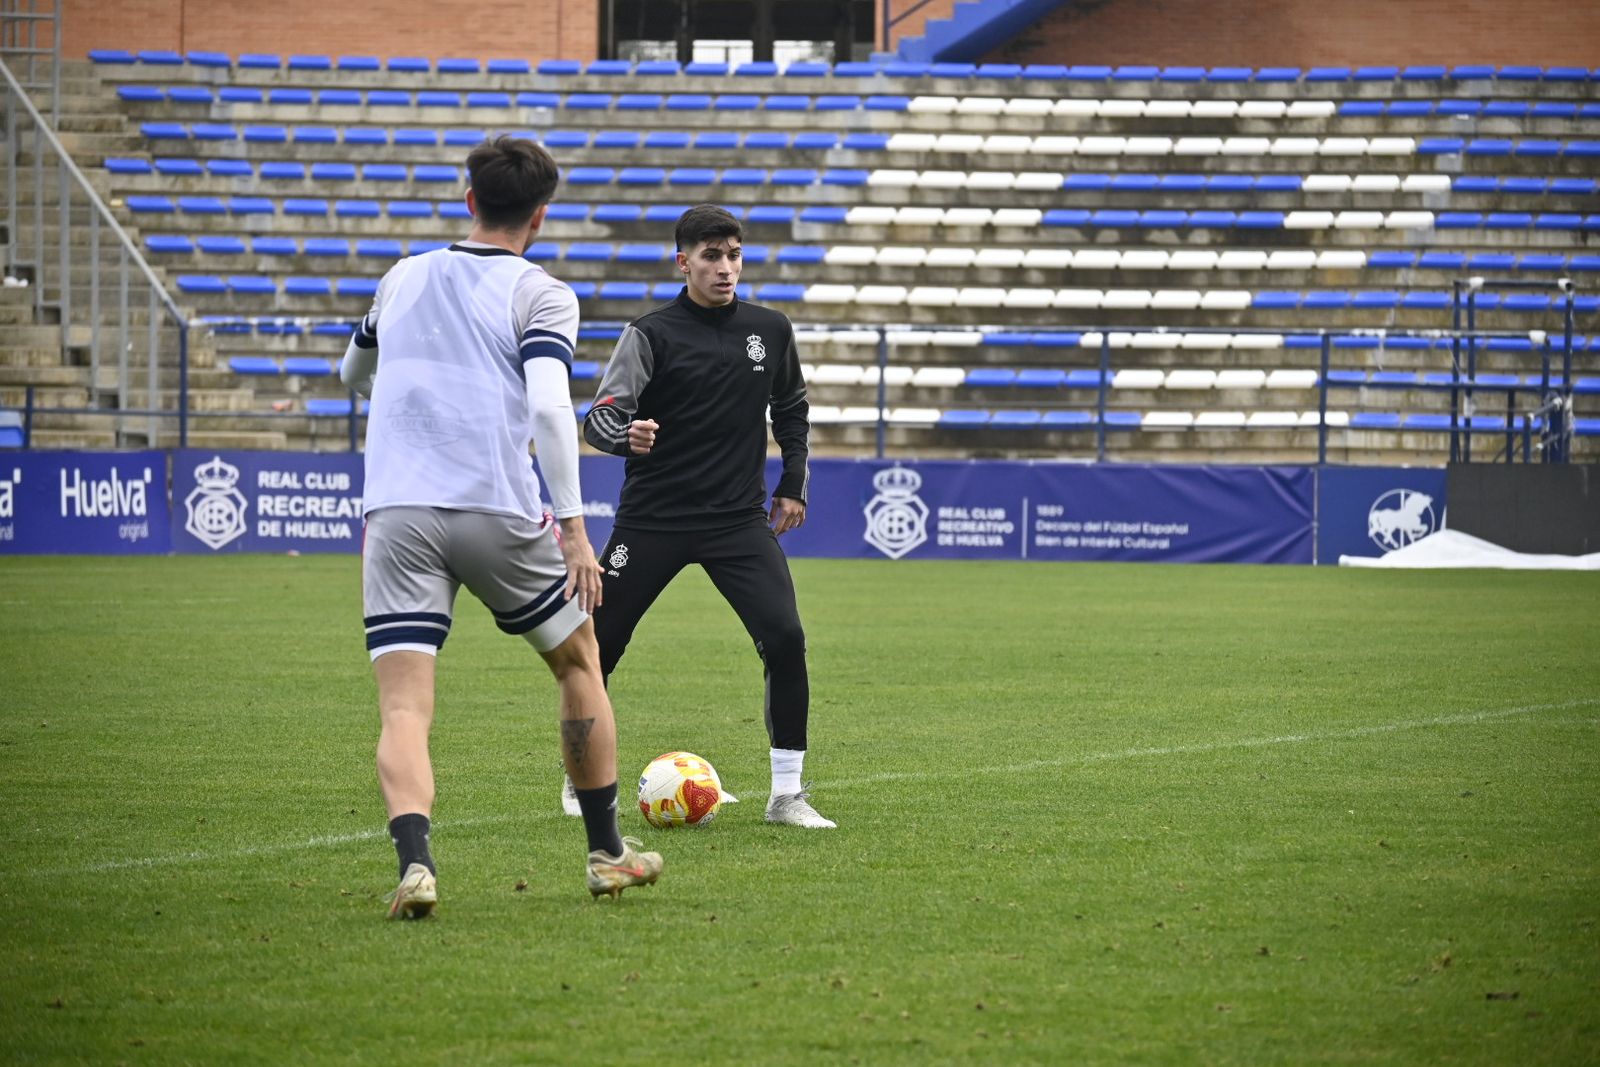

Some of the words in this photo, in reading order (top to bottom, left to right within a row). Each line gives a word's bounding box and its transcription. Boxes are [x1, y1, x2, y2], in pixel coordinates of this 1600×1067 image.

[257, 471, 302, 488] REAL
[304, 473, 350, 490] CLUB
[60, 467, 151, 517] Huelva
[257, 495, 363, 518] RECREAT
[938, 507, 969, 519] REAL
[971, 508, 1005, 520] CLUB
[118, 521, 149, 543] original
[257, 520, 281, 537] DE
[285, 522, 352, 539] HUELVA
[938, 521, 1014, 534] RECREATIVO
[1035, 519, 1081, 532] Decano
[1083, 520, 1102, 533] del
[938, 534, 953, 546] DE
[956, 535, 1004, 546] HUELVA
[1063, 535, 1079, 547] de
[1122, 536, 1170, 549] Cultural
